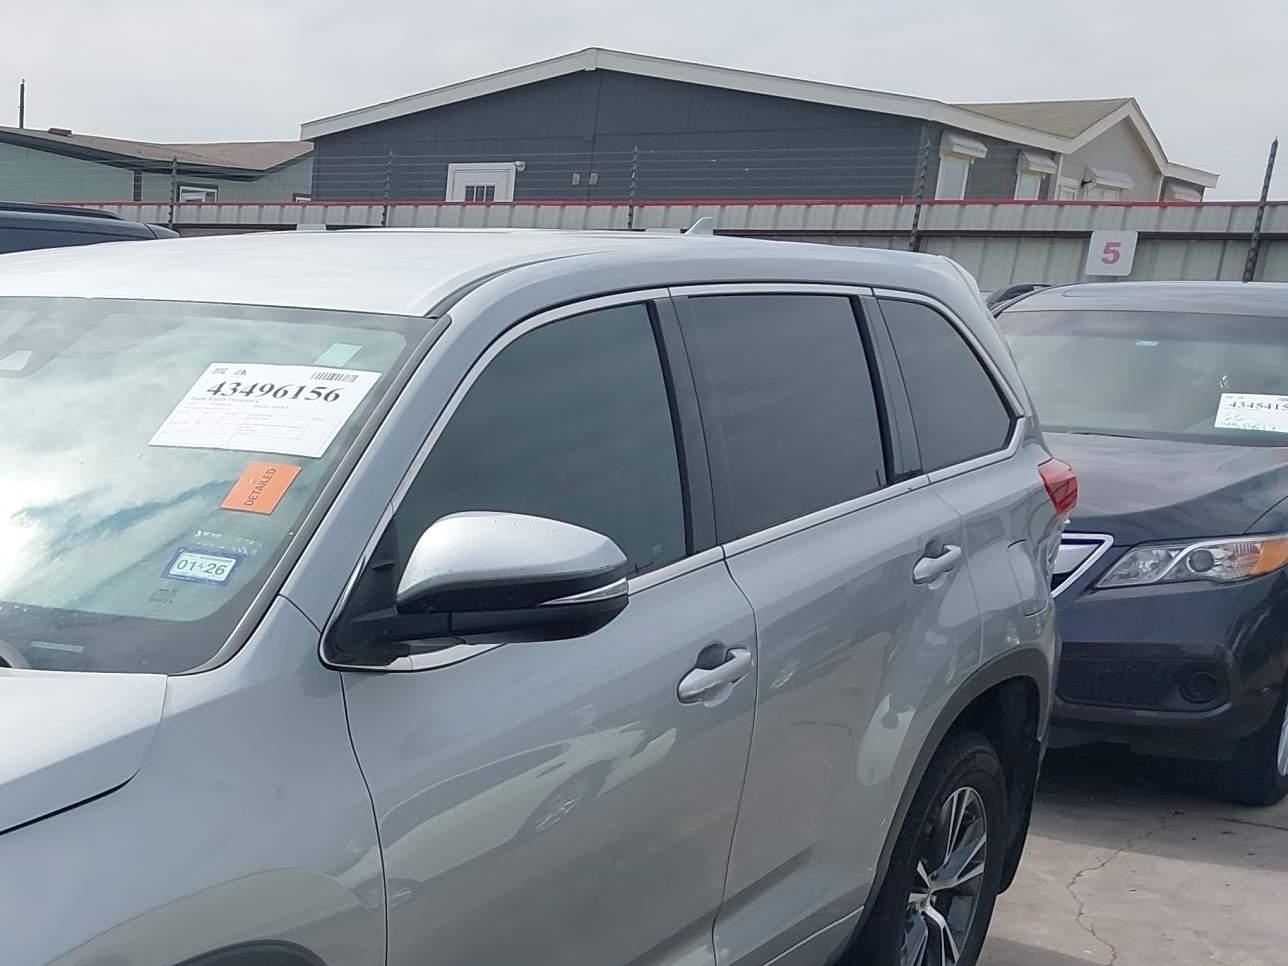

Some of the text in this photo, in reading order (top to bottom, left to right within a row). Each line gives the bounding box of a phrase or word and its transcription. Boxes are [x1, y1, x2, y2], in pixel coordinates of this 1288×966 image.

[1100, 241, 1122, 265] 5
[207, 380, 345, 403] 43496156
[243, 467, 277, 506] DETAILED
[176, 559, 228, 576] 01 26
